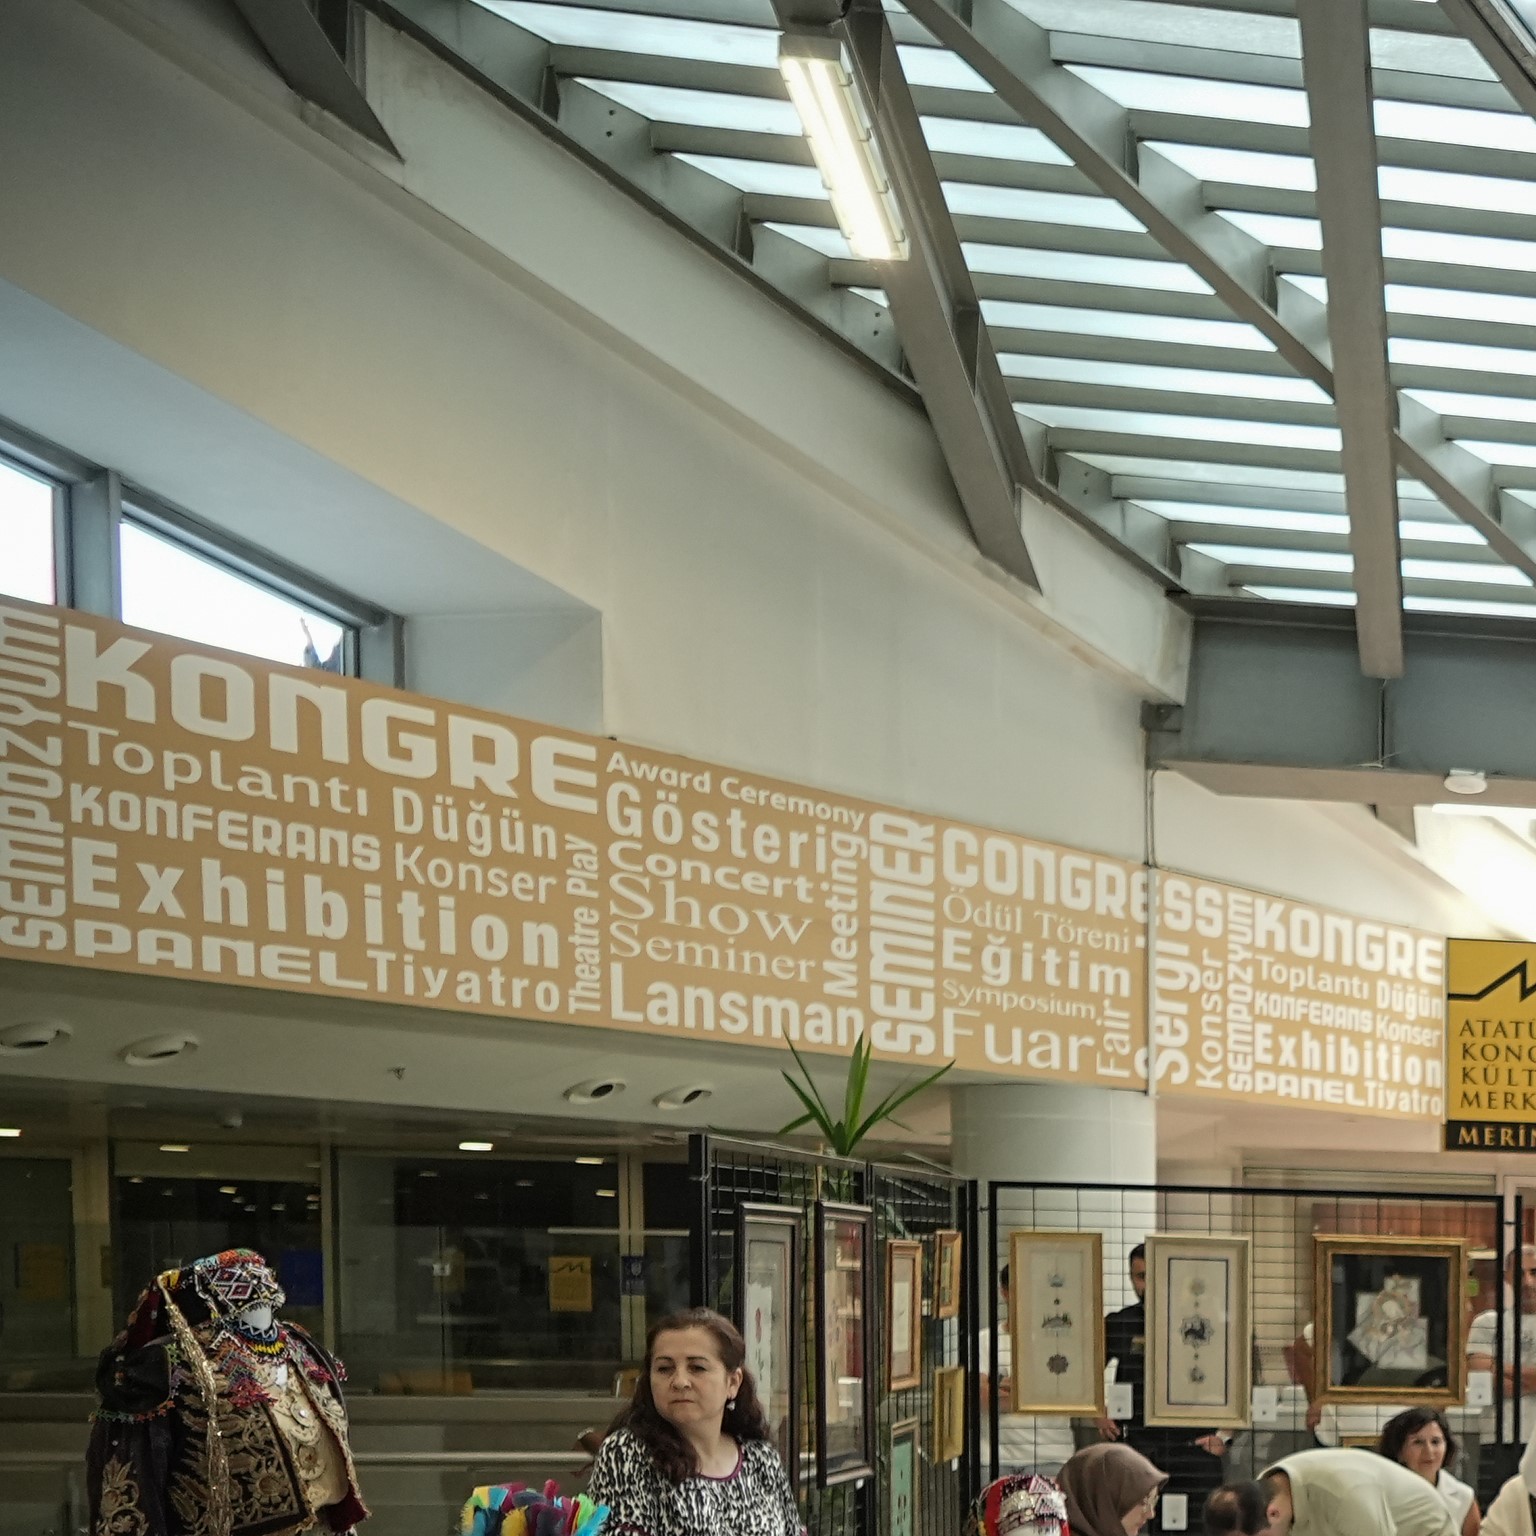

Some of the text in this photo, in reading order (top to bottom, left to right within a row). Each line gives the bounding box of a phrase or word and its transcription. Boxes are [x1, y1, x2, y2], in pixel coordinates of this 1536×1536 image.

[65, 624, 599, 814] KONGRE
[67, 721, 368, 816] Toplantı
[606, 750, 865, 830] Award Ceremony
[70, 782, 381, 872] KONFERANS
[392, 787, 557, 860] Düğün
[606, 781, 826, 875] Gösteri
[71, 836, 559, 969] Exhibition
[395, 842, 557, 905] Konser
[608, 842, 814, 904] Concert
[609, 871, 813, 945] Show
[565, 833, 601, 1014] Theatre Play
[822, 830, 867, 997] Meeting
[943, 886, 1130, 954] Ödül Töreni
[1254, 899, 1443, 985] KONGRE
[74, 919, 368, 990] PANEL
[366, 949, 559, 1013] Tiyatro
[609, 921, 815, 983] Seminer
[942, 927, 1131, 998] Eğitim
[1255, 955, 1369, 1000] Toplantı
[610, 963, 864, 1047] Lansman
[942, 979, 1096, 1020] Symposium
[1195, 948, 1223, 1090] Konser
[1254, 990, 1373, 1033] KONFERANS
[1376, 979, 1443, 1021] Düğün
[1376, 1013, 1441, 1048] Konser
[943, 1008, 1096, 1073] Fuar
[1096, 999, 1132, 1078] Fair
[1254, 1022, 1443, 1088] Exhibition
[1254, 1070, 1366, 1106] PANEL
[1364, 1079, 1442, 1116] Tiyatro
